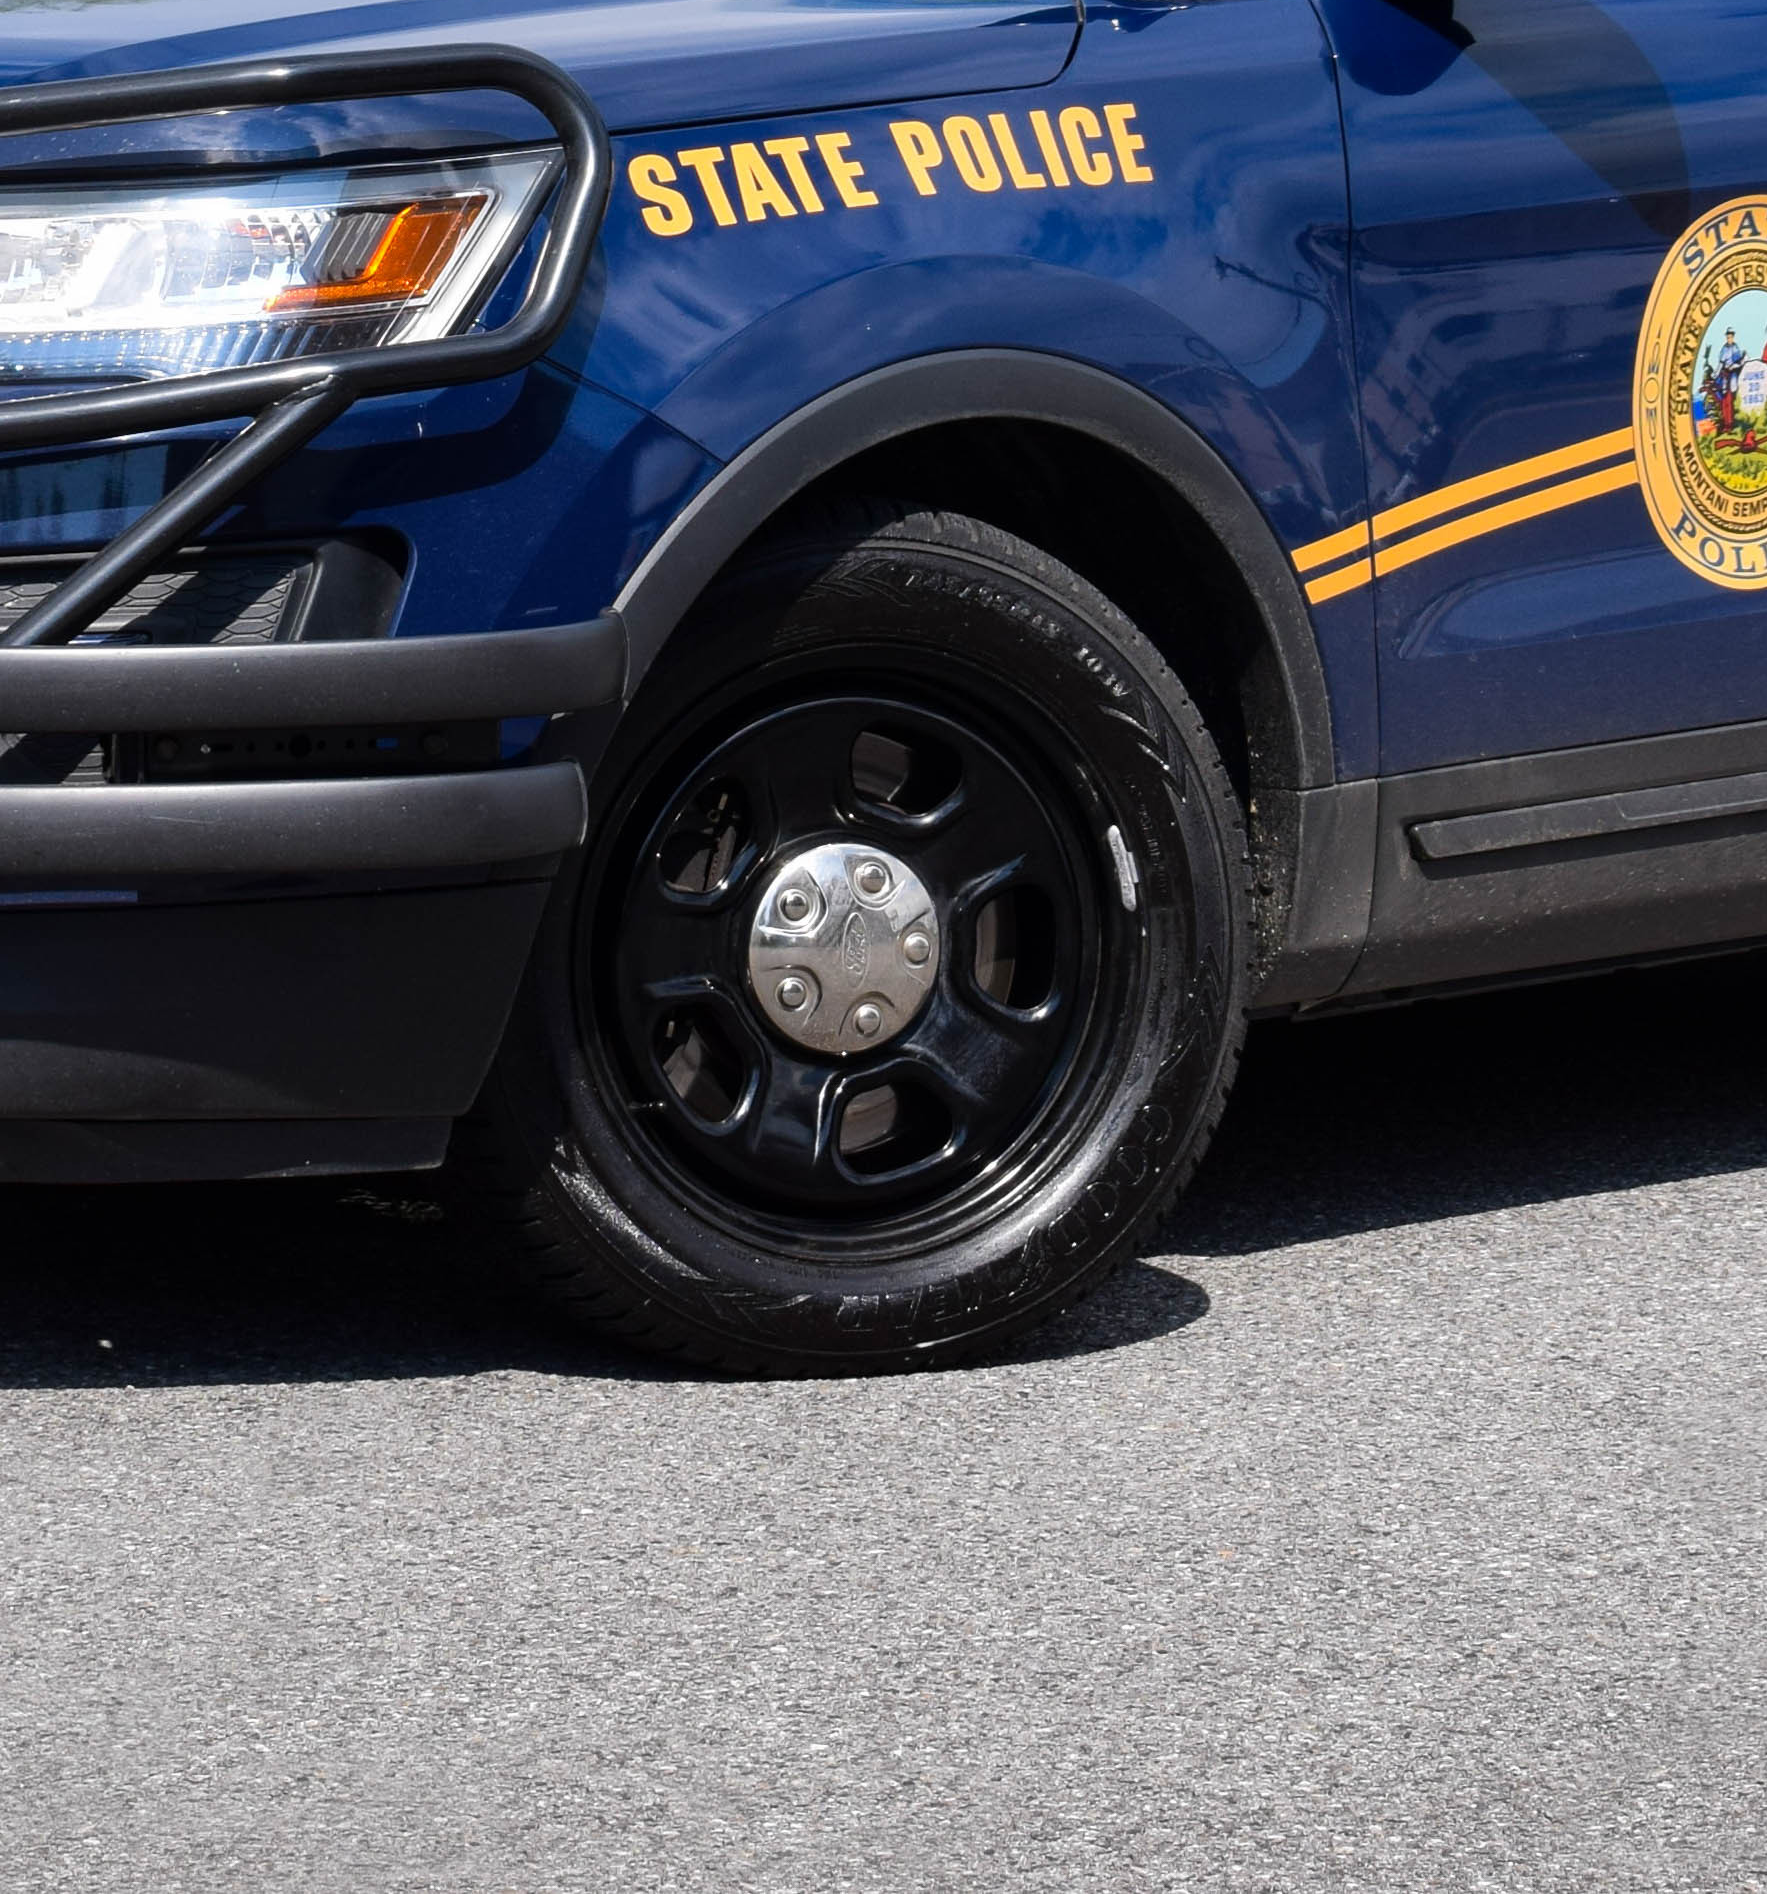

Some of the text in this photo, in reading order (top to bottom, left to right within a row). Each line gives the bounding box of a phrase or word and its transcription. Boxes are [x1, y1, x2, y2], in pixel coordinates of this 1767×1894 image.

[628, 103, 1154, 237] STATE POLICE
[1676, 317, 1702, 416] STATE
[1700, 287, 1723, 318] OF
[1682, 442, 1731, 516] MONTANI
